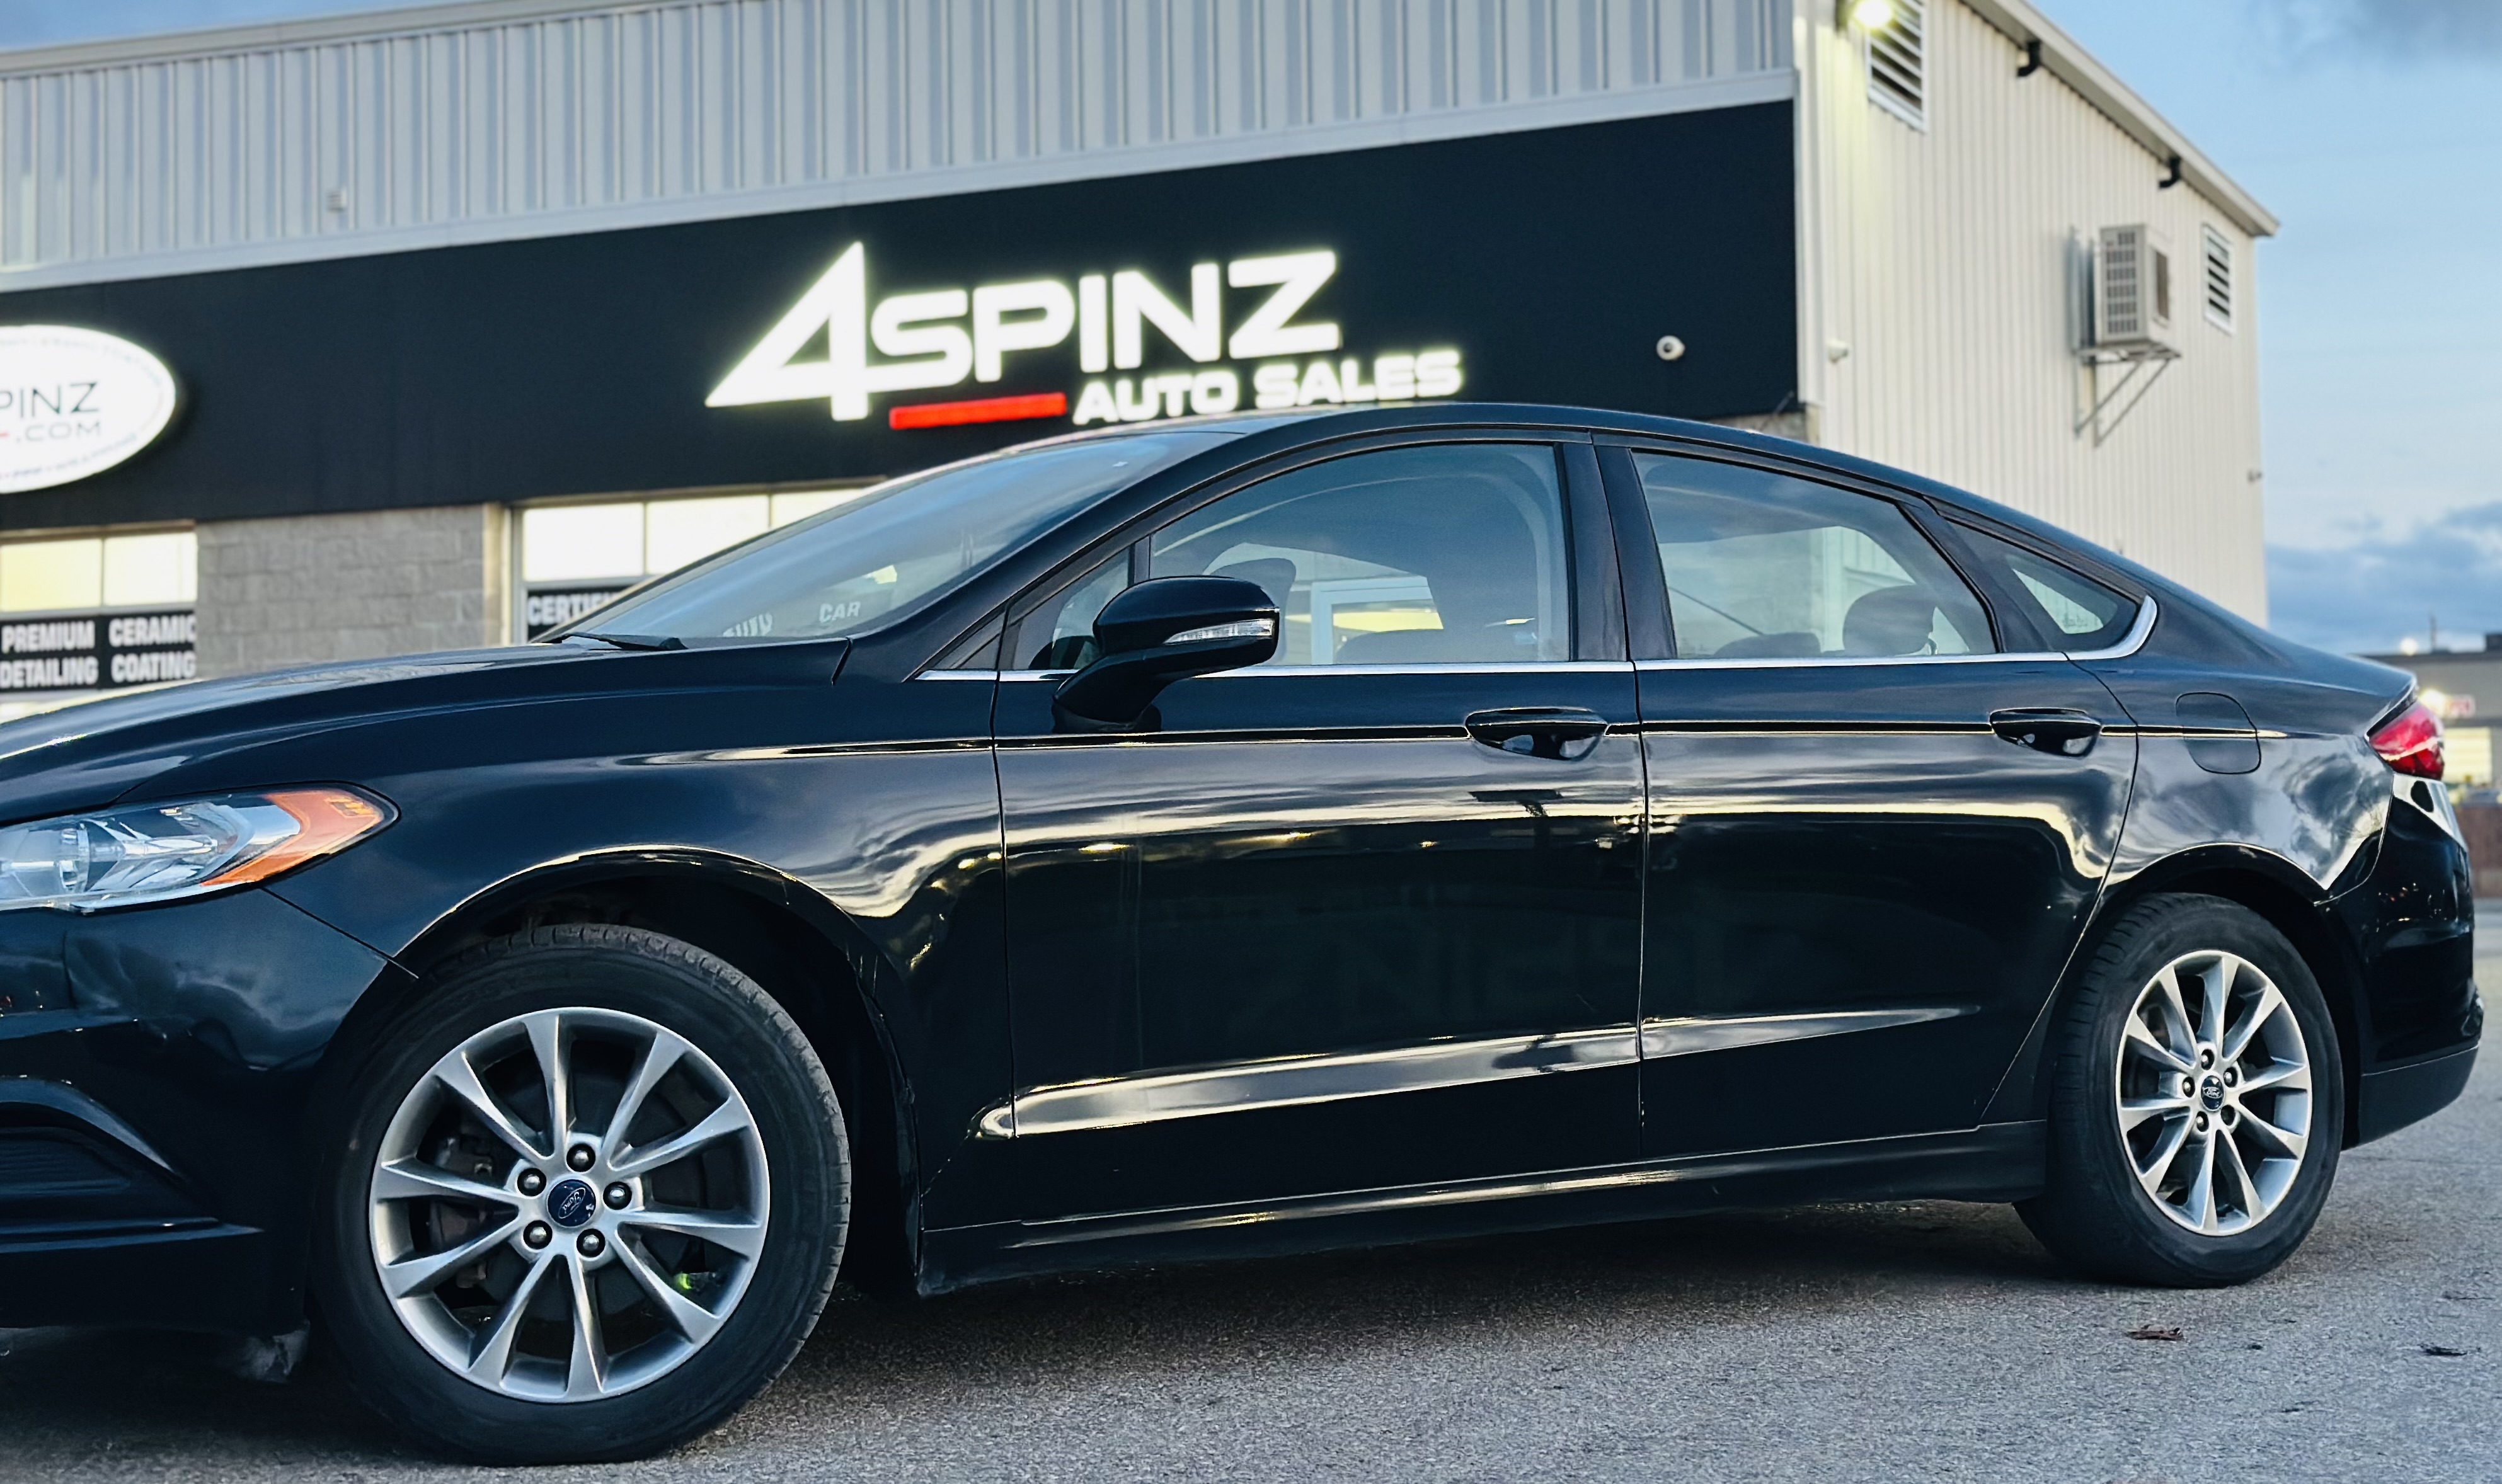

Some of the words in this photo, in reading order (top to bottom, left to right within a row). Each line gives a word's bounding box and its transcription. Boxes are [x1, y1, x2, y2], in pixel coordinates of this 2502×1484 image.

[704, 241, 1341, 421] 4SPINZ
[1072, 370, 1240, 426] AUTO
[1253, 350, 1463, 409] SALES
[819, 600, 861, 624] CAR
[2, 620, 95, 653] PREMIUM
[108, 614, 197, 648] CERAMIC
[0, 655, 99, 688] DETAILING
[111, 649, 197, 683] COATING
